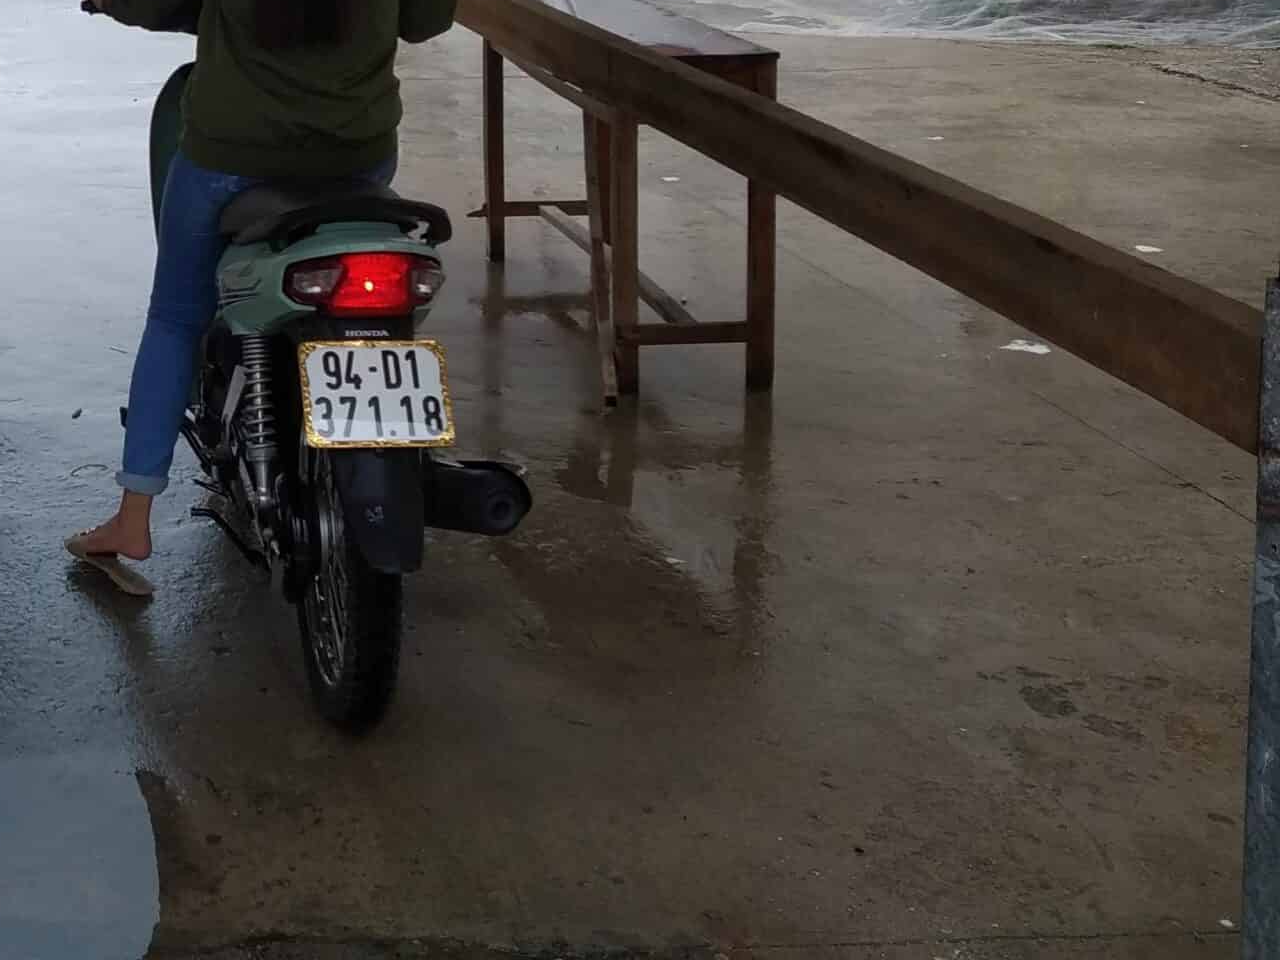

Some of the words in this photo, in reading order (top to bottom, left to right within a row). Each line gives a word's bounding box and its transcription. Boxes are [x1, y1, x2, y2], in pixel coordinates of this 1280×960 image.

[344, 328, 390, 337] HONDA
[322, 349, 420, 391] 94-D1
[314, 394, 443, 438] 371.18
